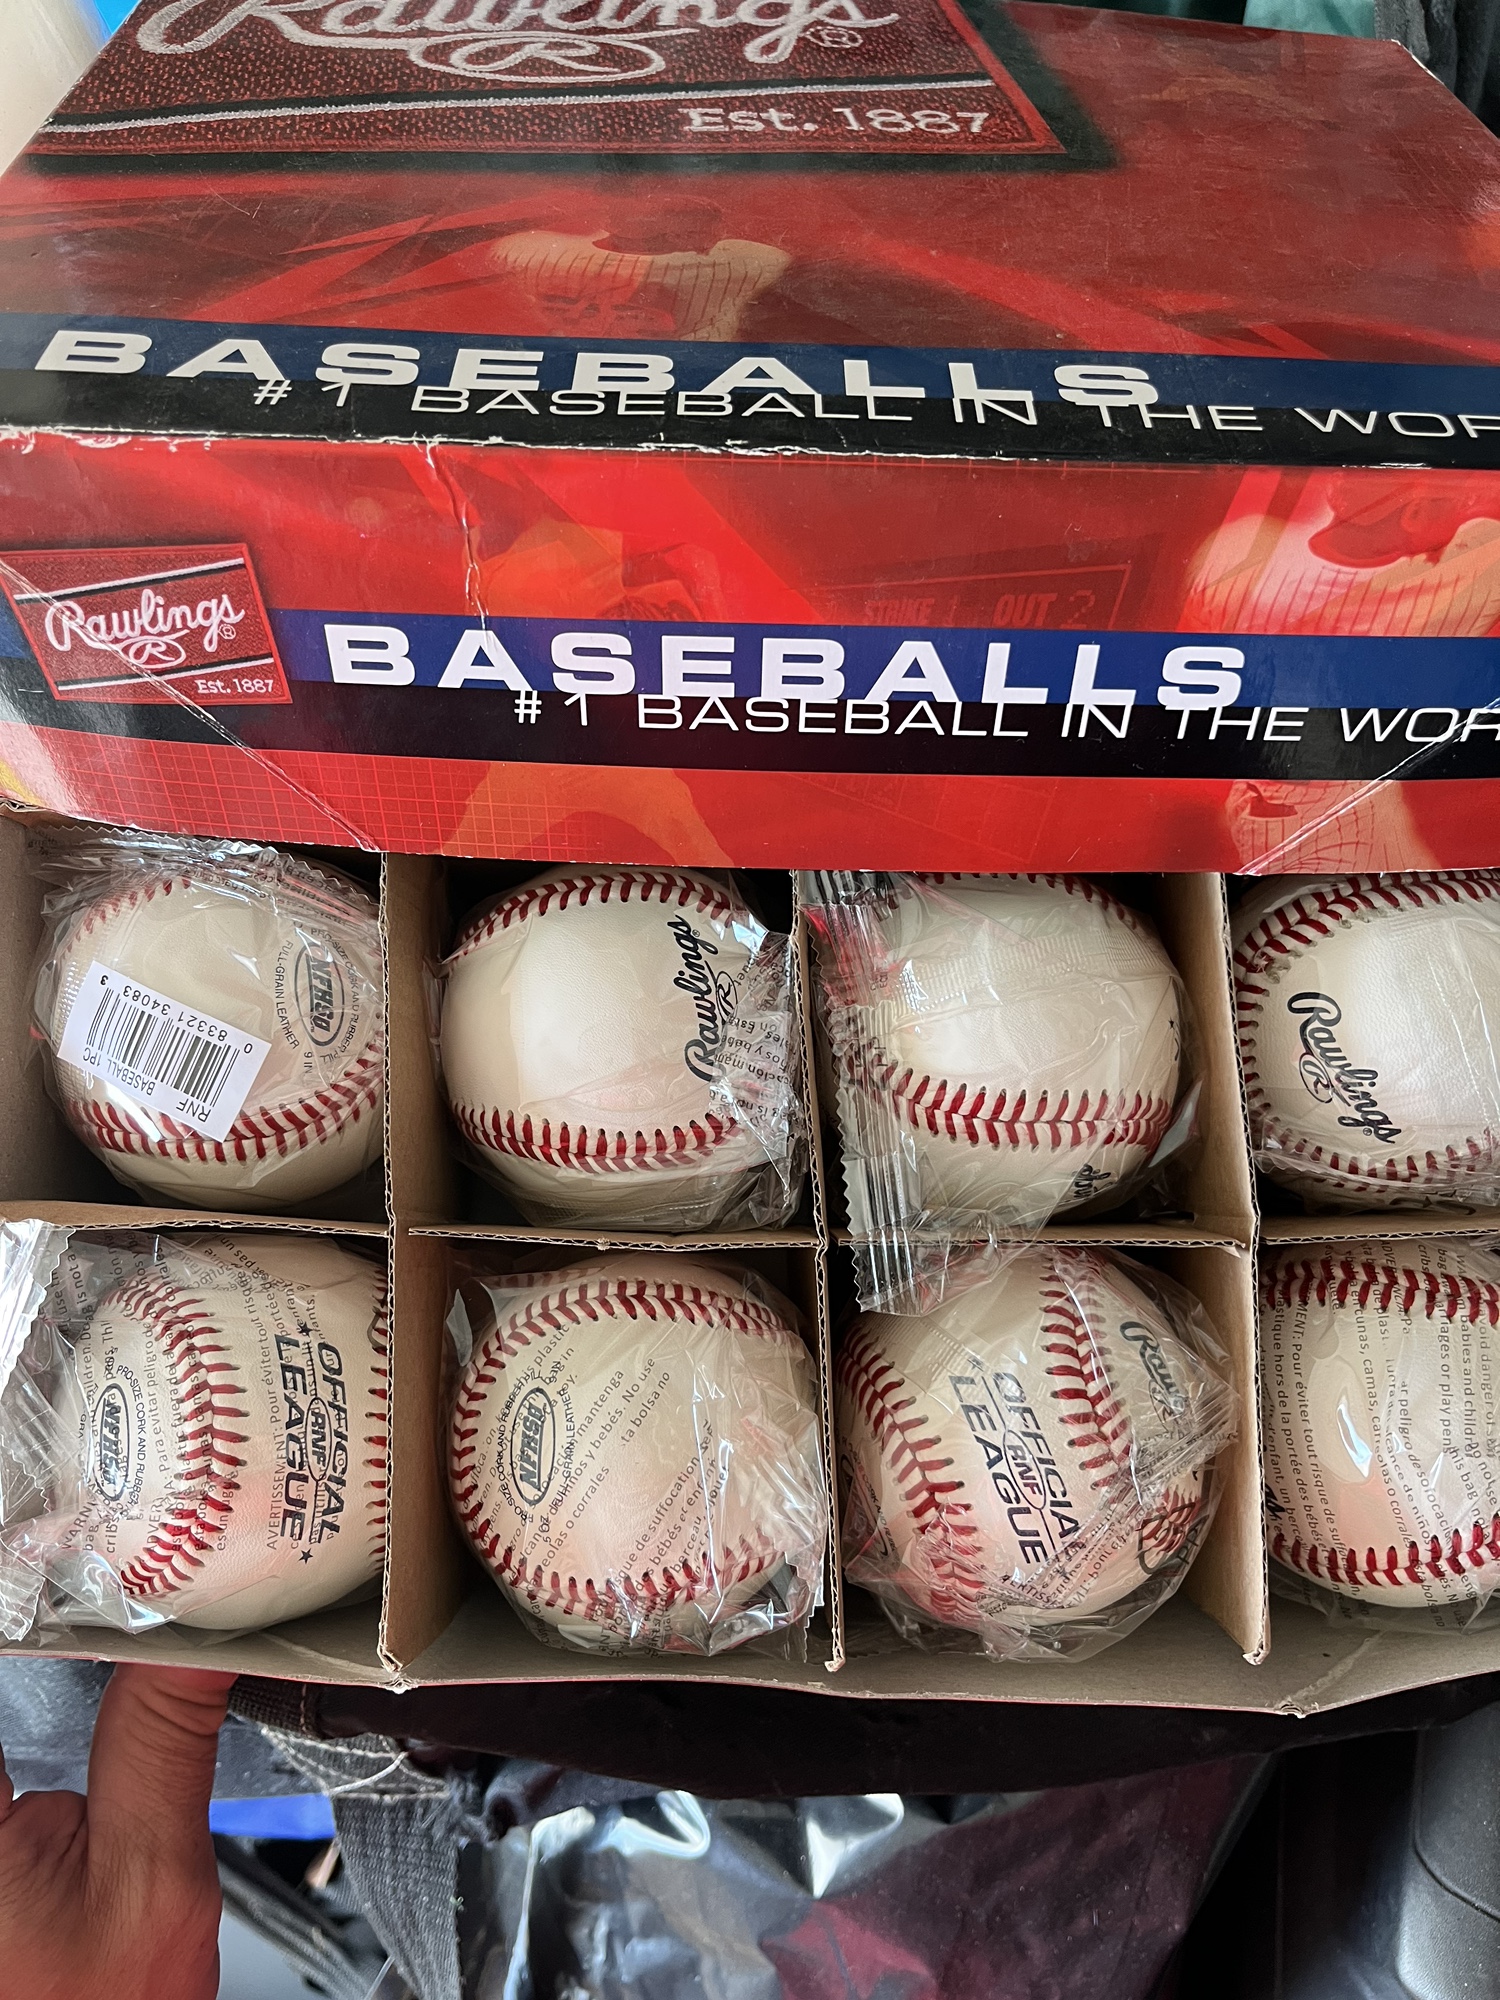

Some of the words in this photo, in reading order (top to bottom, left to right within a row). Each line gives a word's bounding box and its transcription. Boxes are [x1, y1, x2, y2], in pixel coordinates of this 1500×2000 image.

[685, 106, 816, 133] Est.
[839, 106, 991, 134] 1887
[35, 329, 1159, 406] BASEBALLS
[411, 386, 913, 422] BASEBALL
[952, 398, 1038, 426] IN
[1072, 404, 1264, 432] THE
[45, 588, 245, 653] Rawlings
[992, 592, 1058, 627] OUT
[1060, 589, 1095, 629] 2
[195, 679, 231, 694] Est.
[234, 679, 274, 694] 1887
[323, 624, 1245, 711] BASEBALLS
[638, 694, 1029, 737] BASEBALL
[1061, 700, 1132, 739] IN
[1163, 706, 1305, 741] THE
[100, 975, 109, 986] 3
[274, 939, 294, 999] FULL-GRAIN
[123, 985, 171, 1016] 34083
[667, 914, 718, 1083] Rawlings
[177, 1011, 228, 1042] 83321
[275, 1001, 300, 1050] LEATHER
[243, 1043, 253, 1054] 0
[1287, 991, 1402, 1145] Rawlings
[106, 1058, 156, 1096] BASEBALL
[176, 1097, 212, 1123] RNF
[250, 1315, 268, 1344] tout
[534, 1325, 571, 1368] plastic
[1460, 1313, 1473, 1364] babies
[142, 1340, 159, 1391] peligro
[260, 1342, 275, 1387] éviter
[1274, 1354, 1286, 1387] hors
[1291, 1343, 1303, 1379] Pour
[1440, 1363, 1450, 1380] or
[1480, 1352, 1494, 1407] danger
[116, 1365, 143, 1401] PRO-SIZE
[577, 1369, 625, 1438] mantenga
[590, 1406, 627, 1450] bebés.
[621, 1384, 641, 1404] No
[638, 1357, 656, 1383] use
[1277, 1389, 1289, 1408] de
[1355, 1308, 1370, 1355] cunas,
[1363, 1358, 1379, 1412] camas,
[1386, 1487, 1397, 1498] o
[1438, 1382, 1453, 1416] play
[1462, 1370, 1476, 1396] and
[135, 1404, 147, 1437] CORK
[148, 1392, 163, 1436] evitar
[268, 1388, 282, 1424] Pour
[558, 1387, 576, 1438] LEATHER
[1280, 1411, 1292, 1425] la
[1295, 1382, 1311, 1428] éviter
[1398, 1398, 1413, 1450] peligro
[137, 1438, 147, 1461] AND
[274, 1334, 310, 1541] LEAGUE
[311, 1411, 327, 1468] RNF
[317, 1342, 349, 1544] OFFICIAL
[565, 1519, 575, 1530] o
[572, 1465, 610, 1519] corrales
[631, 1391, 661, 1429] bolsa
[658, 1370, 672, 1391] no
[1281, 1427, 1302, 1476] portée
[1302, 1428, 1318, 1465] tout
[949, 1375, 1050, 1565] LEAGUE
[1006, 1444, 1043, 1497] RNF
[1295, 1478, 1310, 1501] des
[1310, 1463, 1329, 1506] risque
[1460, 1469, 1479, 1501] bag
[635, 1532, 651, 1552] de
[649, 1455, 700, 1534] suffocation
[1279, 1487, 1292, 1505] un
[1323, 1507, 1335, 1524] de
[649, 1522, 682, 1566] bébés
[1412, 1504, 1431, 1546] niños
